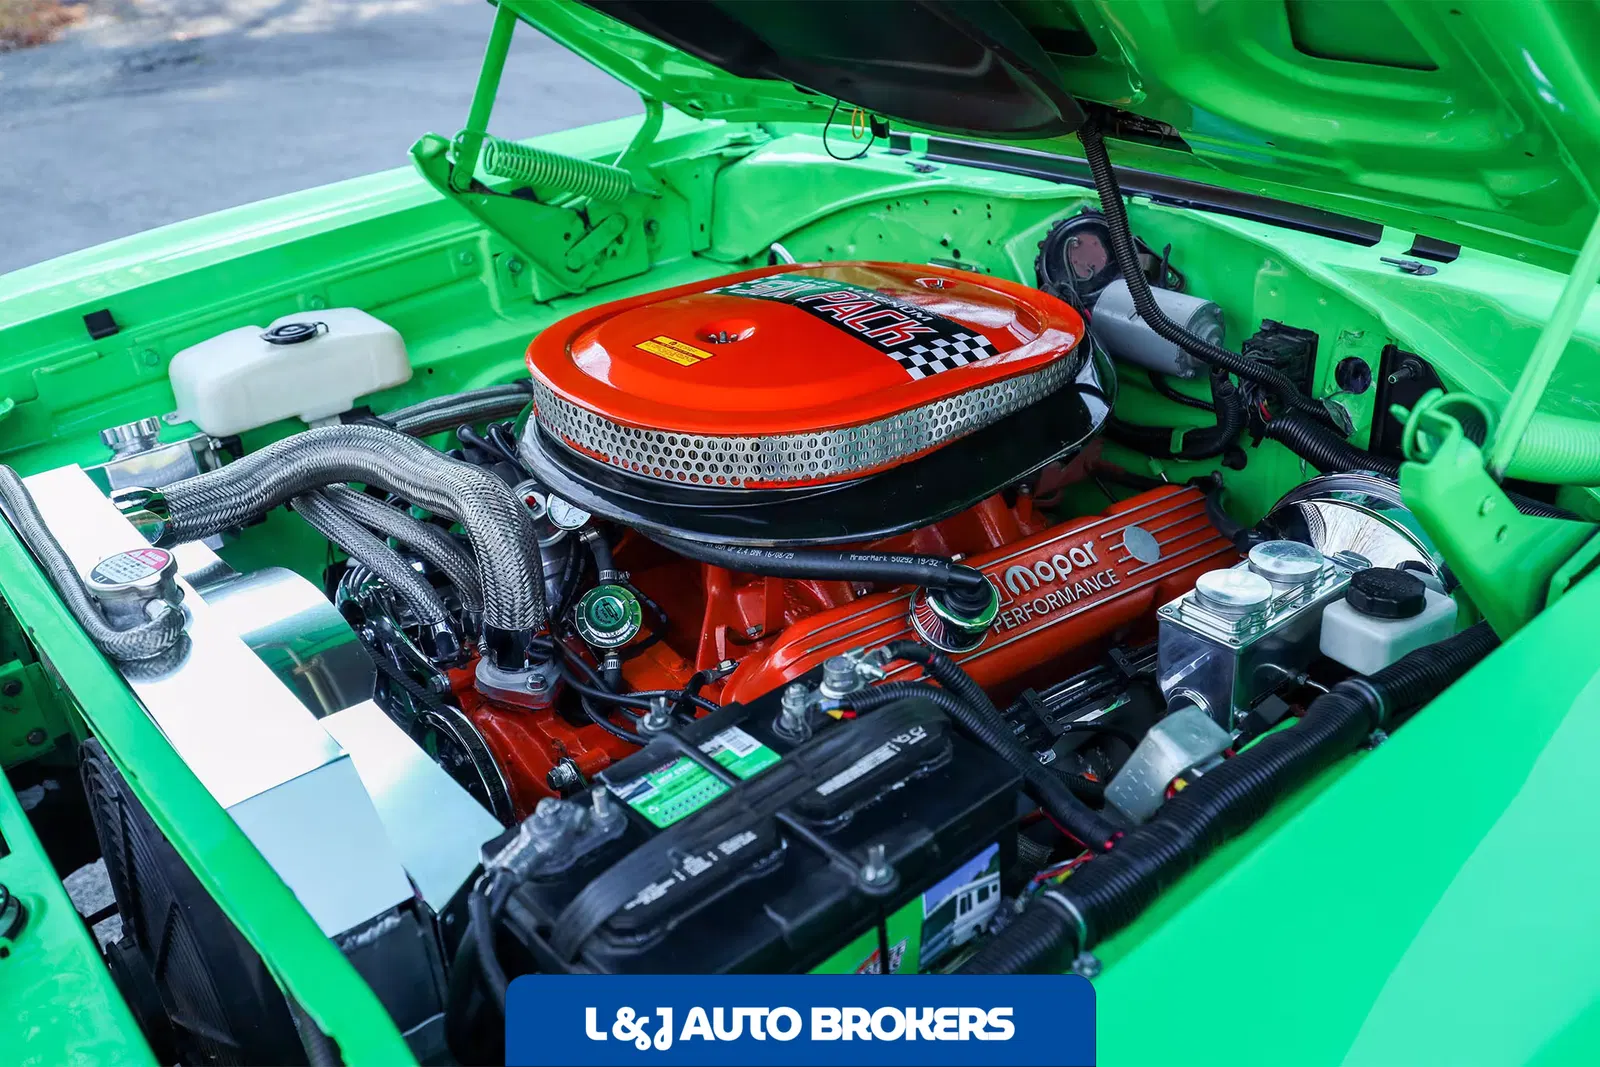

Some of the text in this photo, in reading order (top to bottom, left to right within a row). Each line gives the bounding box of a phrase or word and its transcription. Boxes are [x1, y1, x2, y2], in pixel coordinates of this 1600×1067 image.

[796, 289, 938, 347] PACK
[848, 287, 934, 321] MAGNUM
[849, 554, 888, 562] ArmorMark
[1005, 540, 1099, 596] Mopar
[992, 568, 1121, 634] PERFORMANCE
